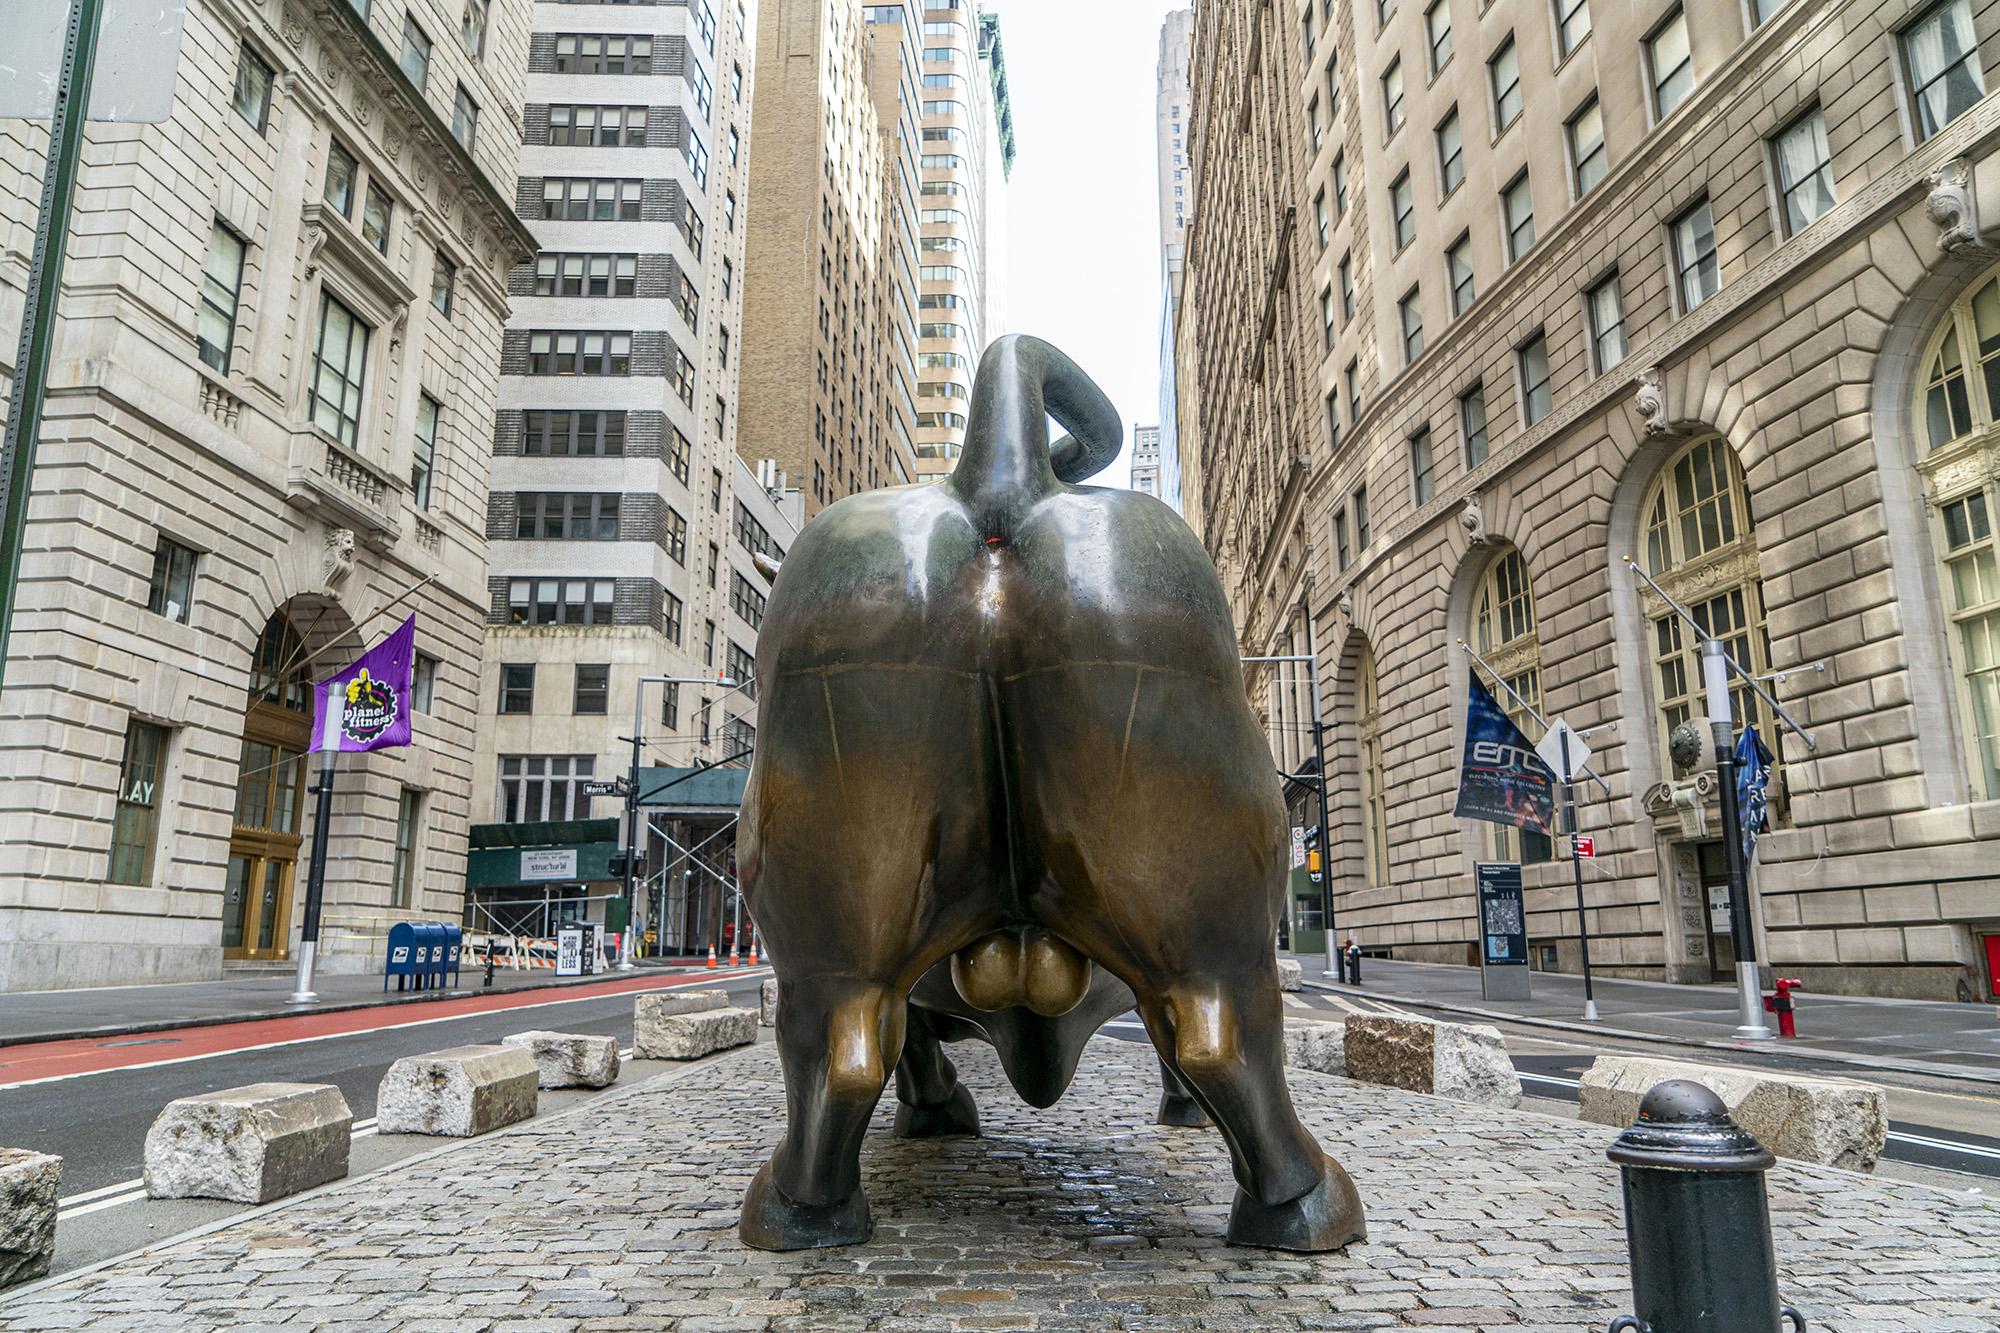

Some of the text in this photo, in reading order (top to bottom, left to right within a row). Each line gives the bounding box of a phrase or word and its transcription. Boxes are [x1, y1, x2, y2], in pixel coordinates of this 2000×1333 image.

[344, 706, 384, 721] planet
[349, 714, 390, 728] fitness
[586, 785, 607, 793] Morris
[1469, 774, 1498, 782] ELECTRONIC
[1516, 780, 1546, 791] COLLECTIVE
[562, 959, 577, 969] LESS
